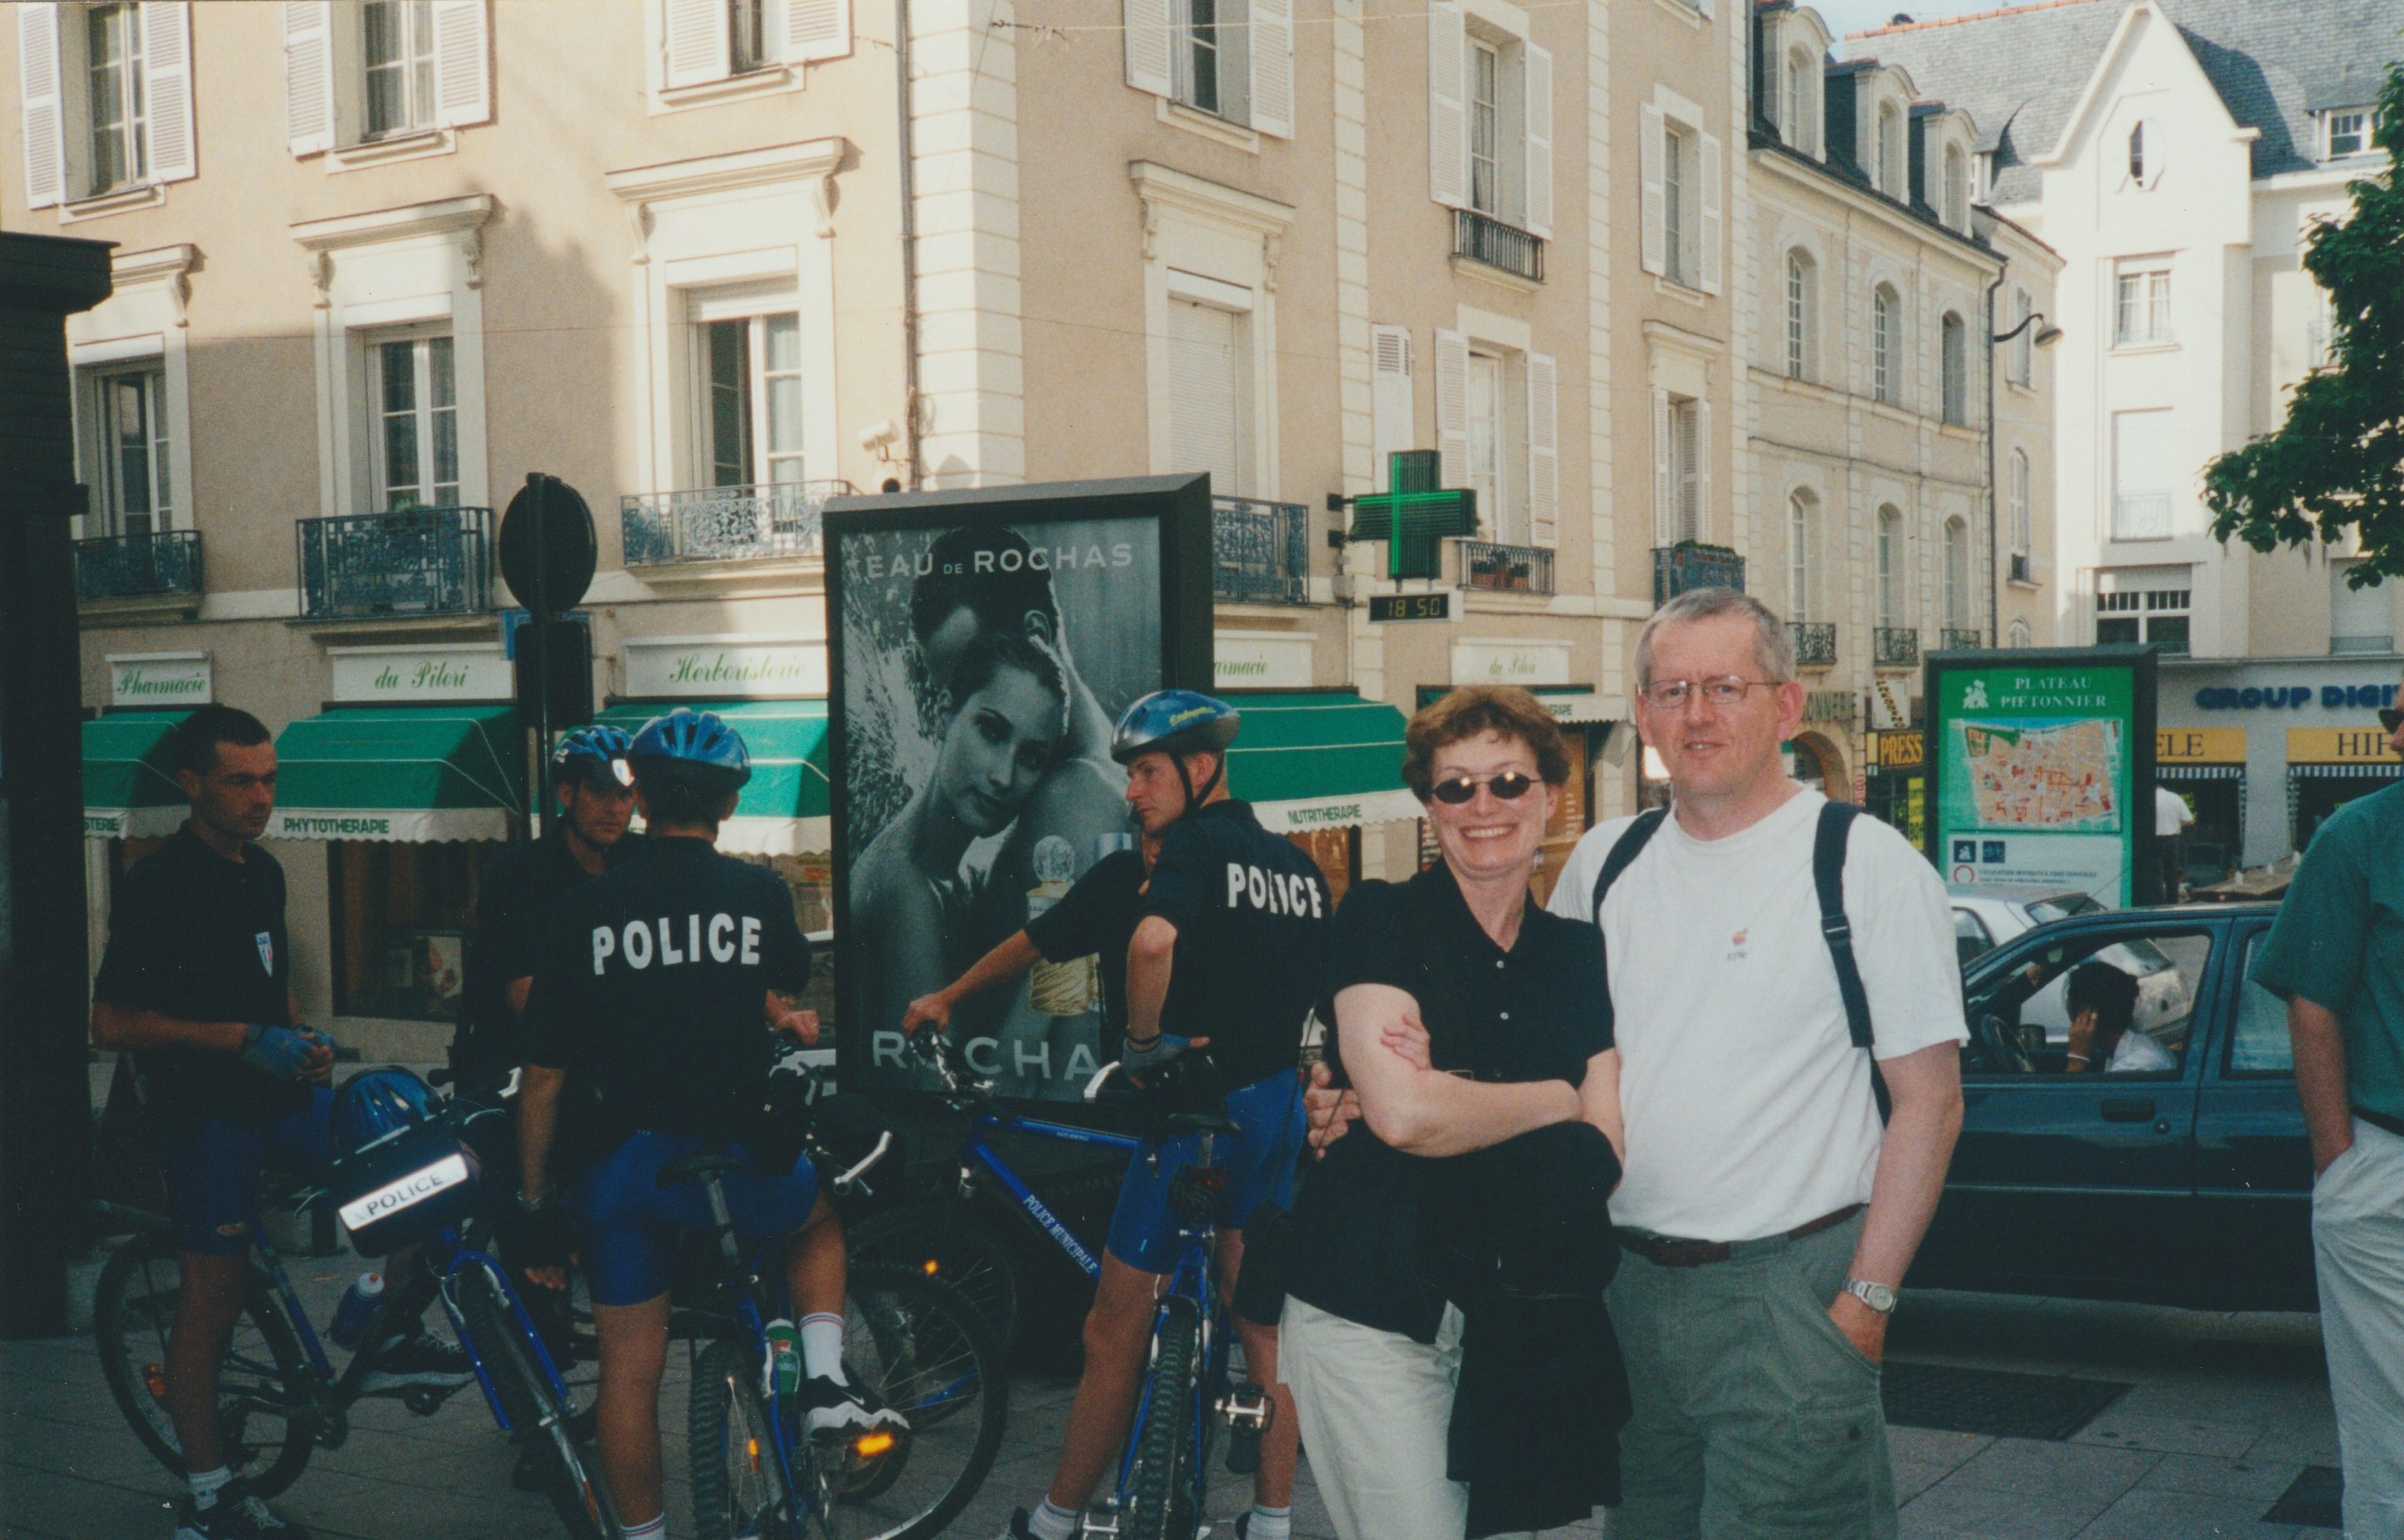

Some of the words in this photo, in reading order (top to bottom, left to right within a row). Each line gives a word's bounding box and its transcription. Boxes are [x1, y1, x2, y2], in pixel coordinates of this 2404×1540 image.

[866, 553, 933, 578] EAU
[943, 564, 963, 575] DE
[974, 544, 1132, 573] ROCHAS
[1417, 597, 1440, 616] 50
[115, 670, 206, 695] Pharmacie
[374, 665, 399, 689] du
[411, 661, 469, 689] Pilori
[668, 652, 806, 683] Herboristerie
[2015, 677, 2091, 690] PLATEAU
[2195, 686, 2312, 710] GROUP
[1879, 734, 1924, 766] PRESS
[283, 817, 389, 834] PHYTOTHERAPIE
[1288, 804, 1362, 825] NUTRITHERAPIE
[1227, 863, 1322, 918] POLICE
[592, 913, 762, 975] POLICE
[872, 1030, 1102, 1081] RCHA
[366, 1172, 445, 1216] POLICE
[1023, 1194, 1054, 1230] POLICE
[1051, 1223, 1098, 1274] MUNICIPALE
